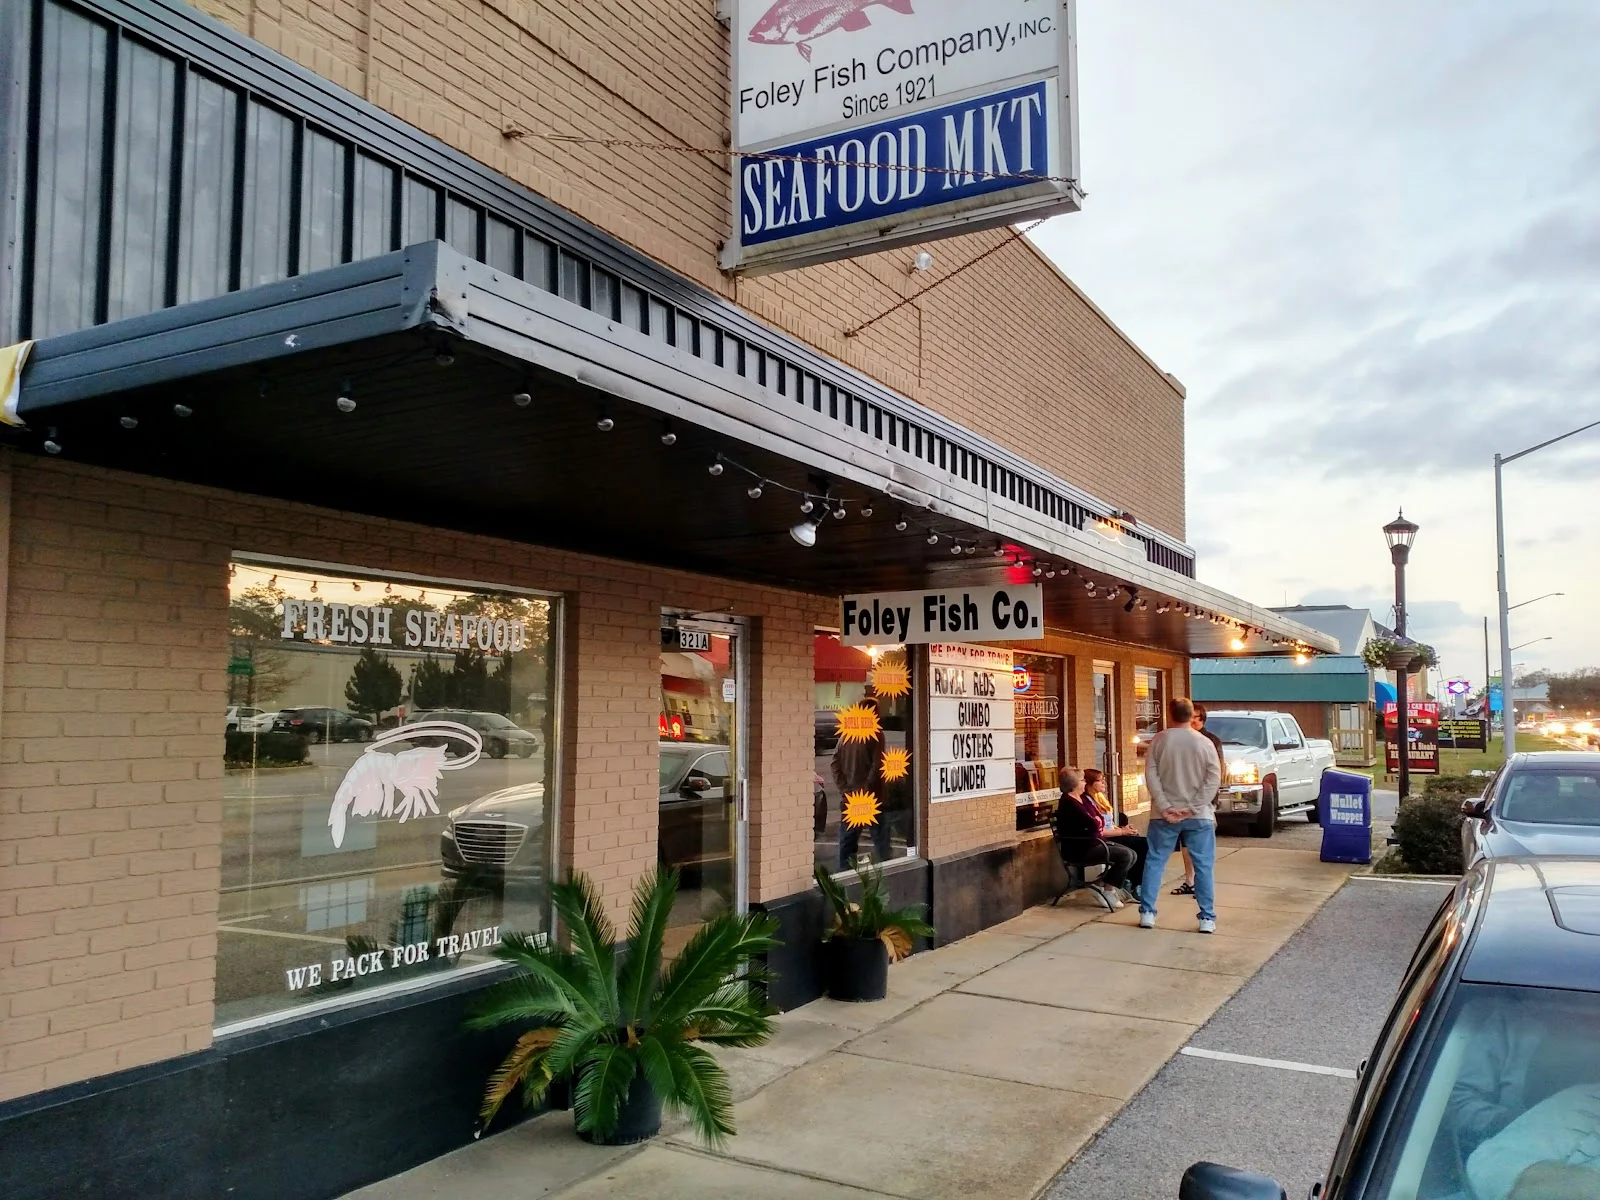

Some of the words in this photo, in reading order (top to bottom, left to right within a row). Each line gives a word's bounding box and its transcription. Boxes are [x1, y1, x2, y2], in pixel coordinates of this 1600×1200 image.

[740, 79, 804, 113] Foley
[814, 58, 866, 93] Fish
[876, 22, 1016, 75] Company,
[1018, 16, 1057, 39] INC.
[842, 90, 889, 119] Since
[895, 75, 936, 106] 1921
[744, 124, 926, 235] SEAFOOD
[942, 92, 1041, 190] MKT
[281, 598, 393, 645] FRESH
[405, 608, 526, 652] SEAFOOD
[843, 598, 911, 642] Foley
[923, 593, 979, 633] Fish
[992, 590, 1038, 630] Co.
[681, 632, 708, 650] 321A
[934, 667, 967, 696] ROYAL
[973, 671, 996, 697] REDS
[1012, 672, 1030, 687] PEN
[958, 701, 990, 728] GUMBO
[952, 732, 993, 759] OYSTERS
[940, 764, 986, 794] FLOUNDER
[1330, 793, 1363, 809] Mullet
[1330, 808, 1363, 824] Wrapper
[286, 964, 322, 991] WE
[331, 949, 384, 981] PACK
[392, 941, 430, 968] FOR
[436, 925, 502, 958] TRAVEL
